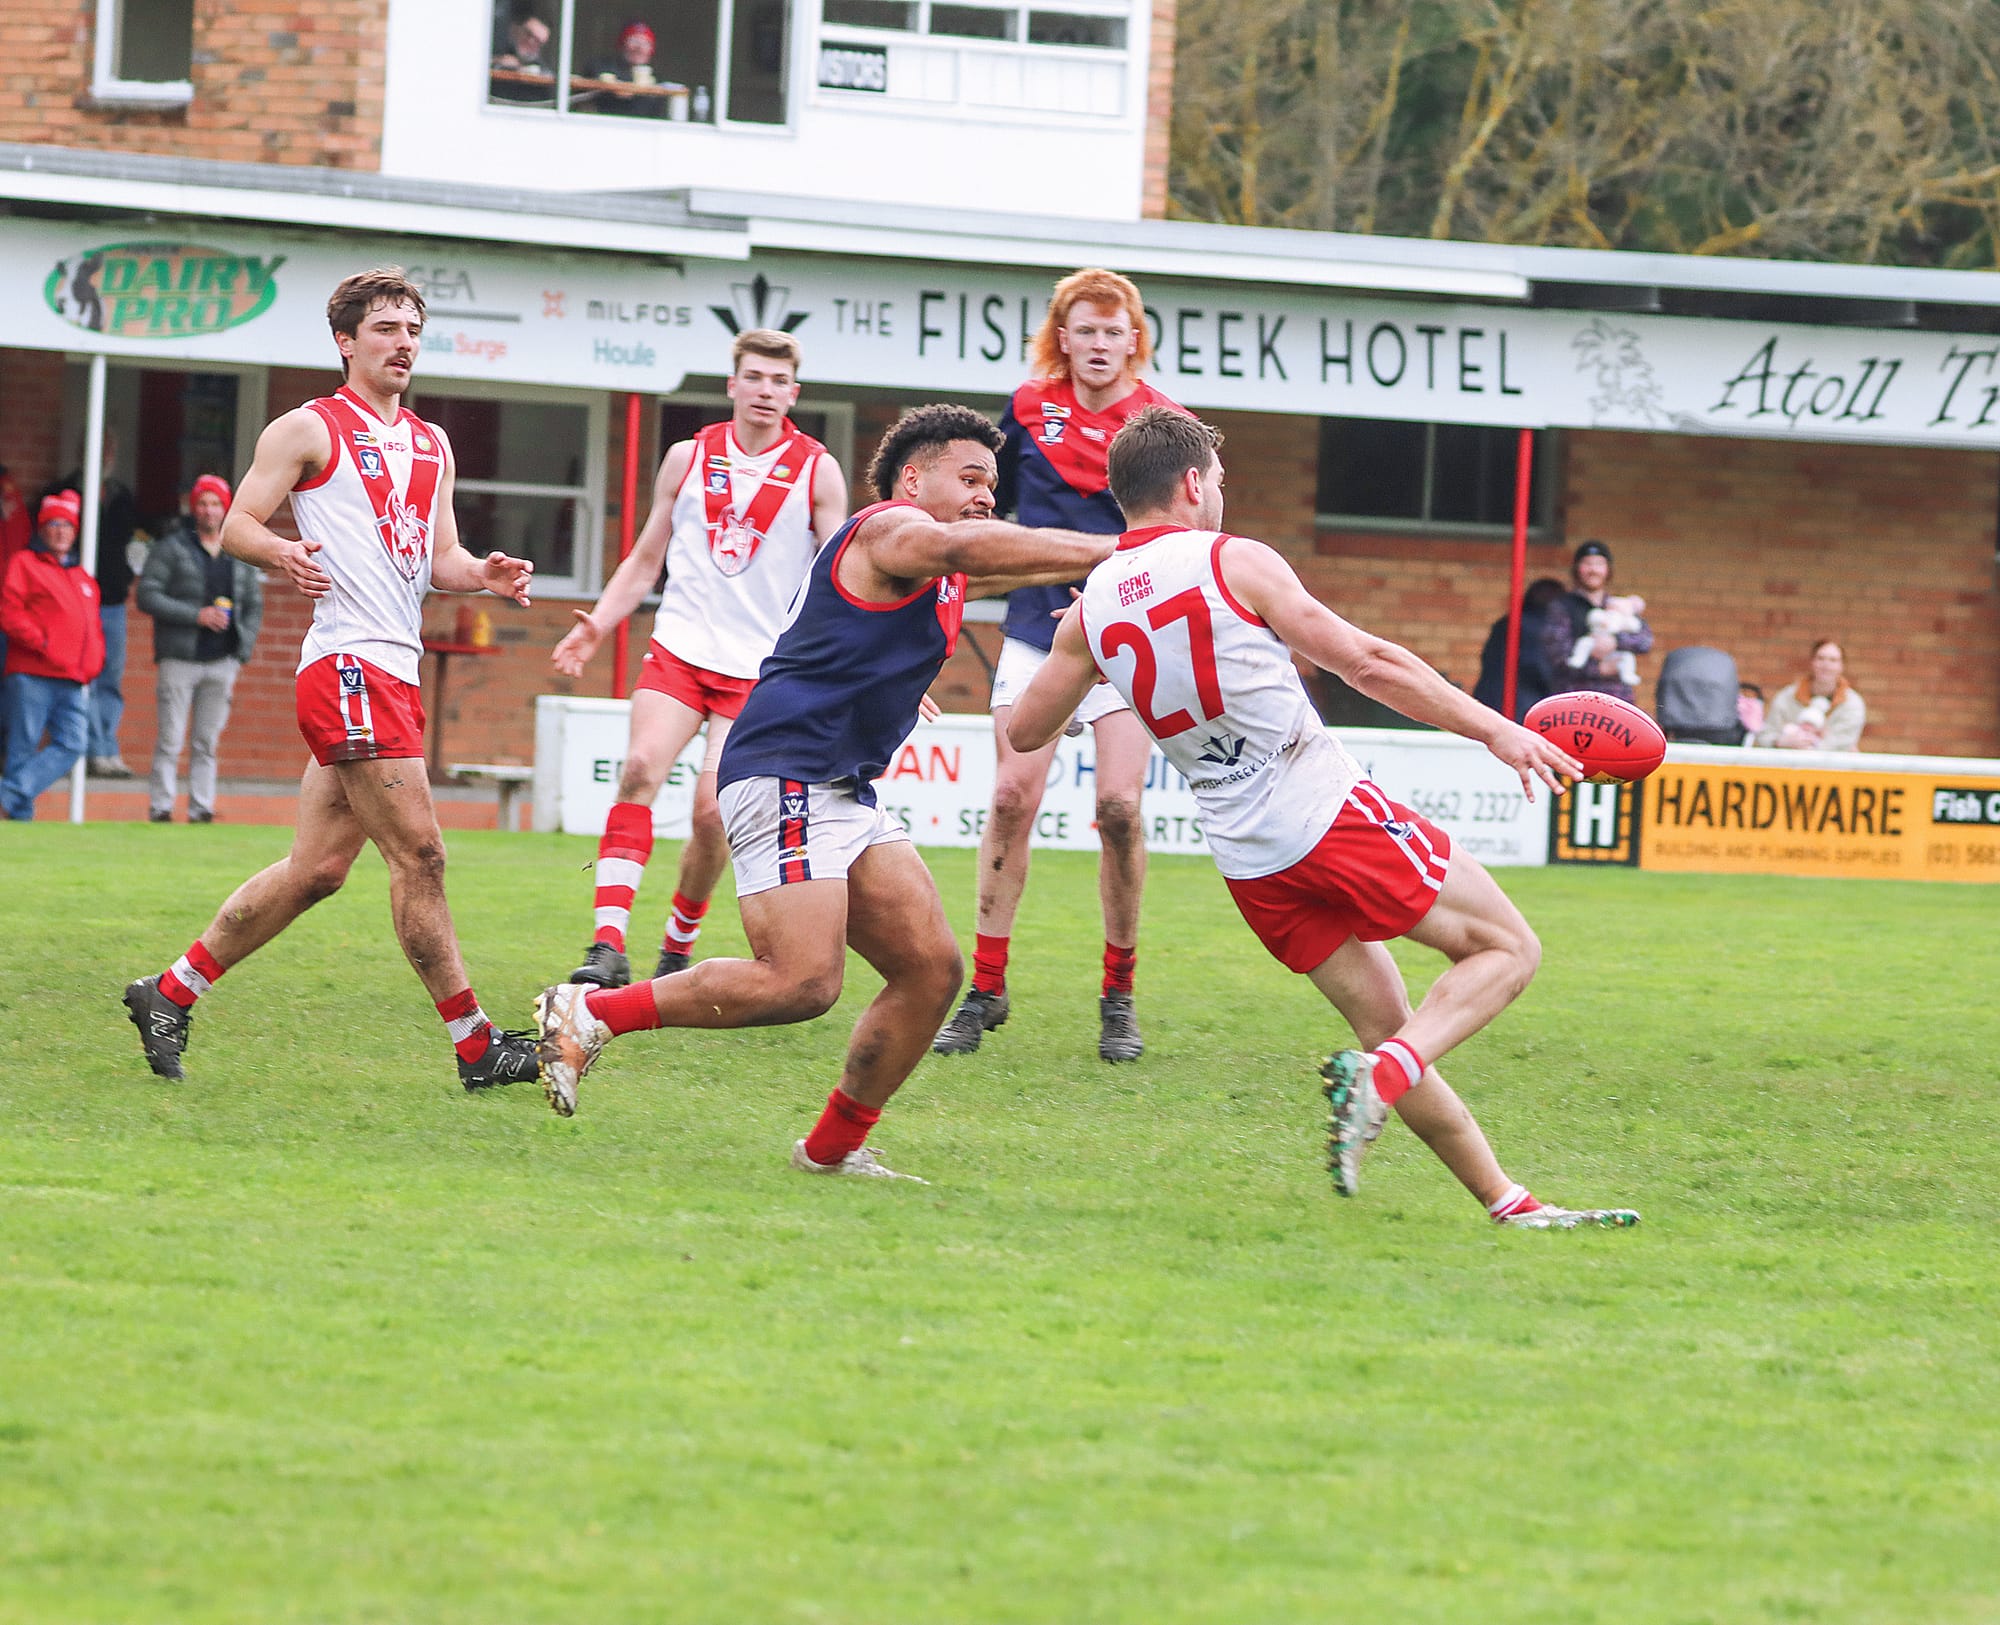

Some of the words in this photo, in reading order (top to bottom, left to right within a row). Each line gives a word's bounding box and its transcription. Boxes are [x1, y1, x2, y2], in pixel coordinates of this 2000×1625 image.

[101, 257, 287, 293] DAIRY
[112, 297, 233, 332] PRO
[588, 299, 692, 326] MILFOS
[593, 337, 656, 367] Houle
[833, 298, 893, 336] THE
[1142, 306, 1288, 382] REEK
[1319, 316, 1523, 396] HOTEL
[1708, 335, 1902, 420] Atoll
[1118, 571, 1151, 597] FCFNC
[1100, 586, 1225, 740] 27
[1538, 710, 1638, 748] SHERRIN
[1473, 791, 1523, 823] 2327
[1656, 778, 1904, 835] HARDWARE
[1934, 791, 1982, 821] Fish
[959, 808, 1069, 839] SECE
[1143, 816, 1203, 843] RTS
